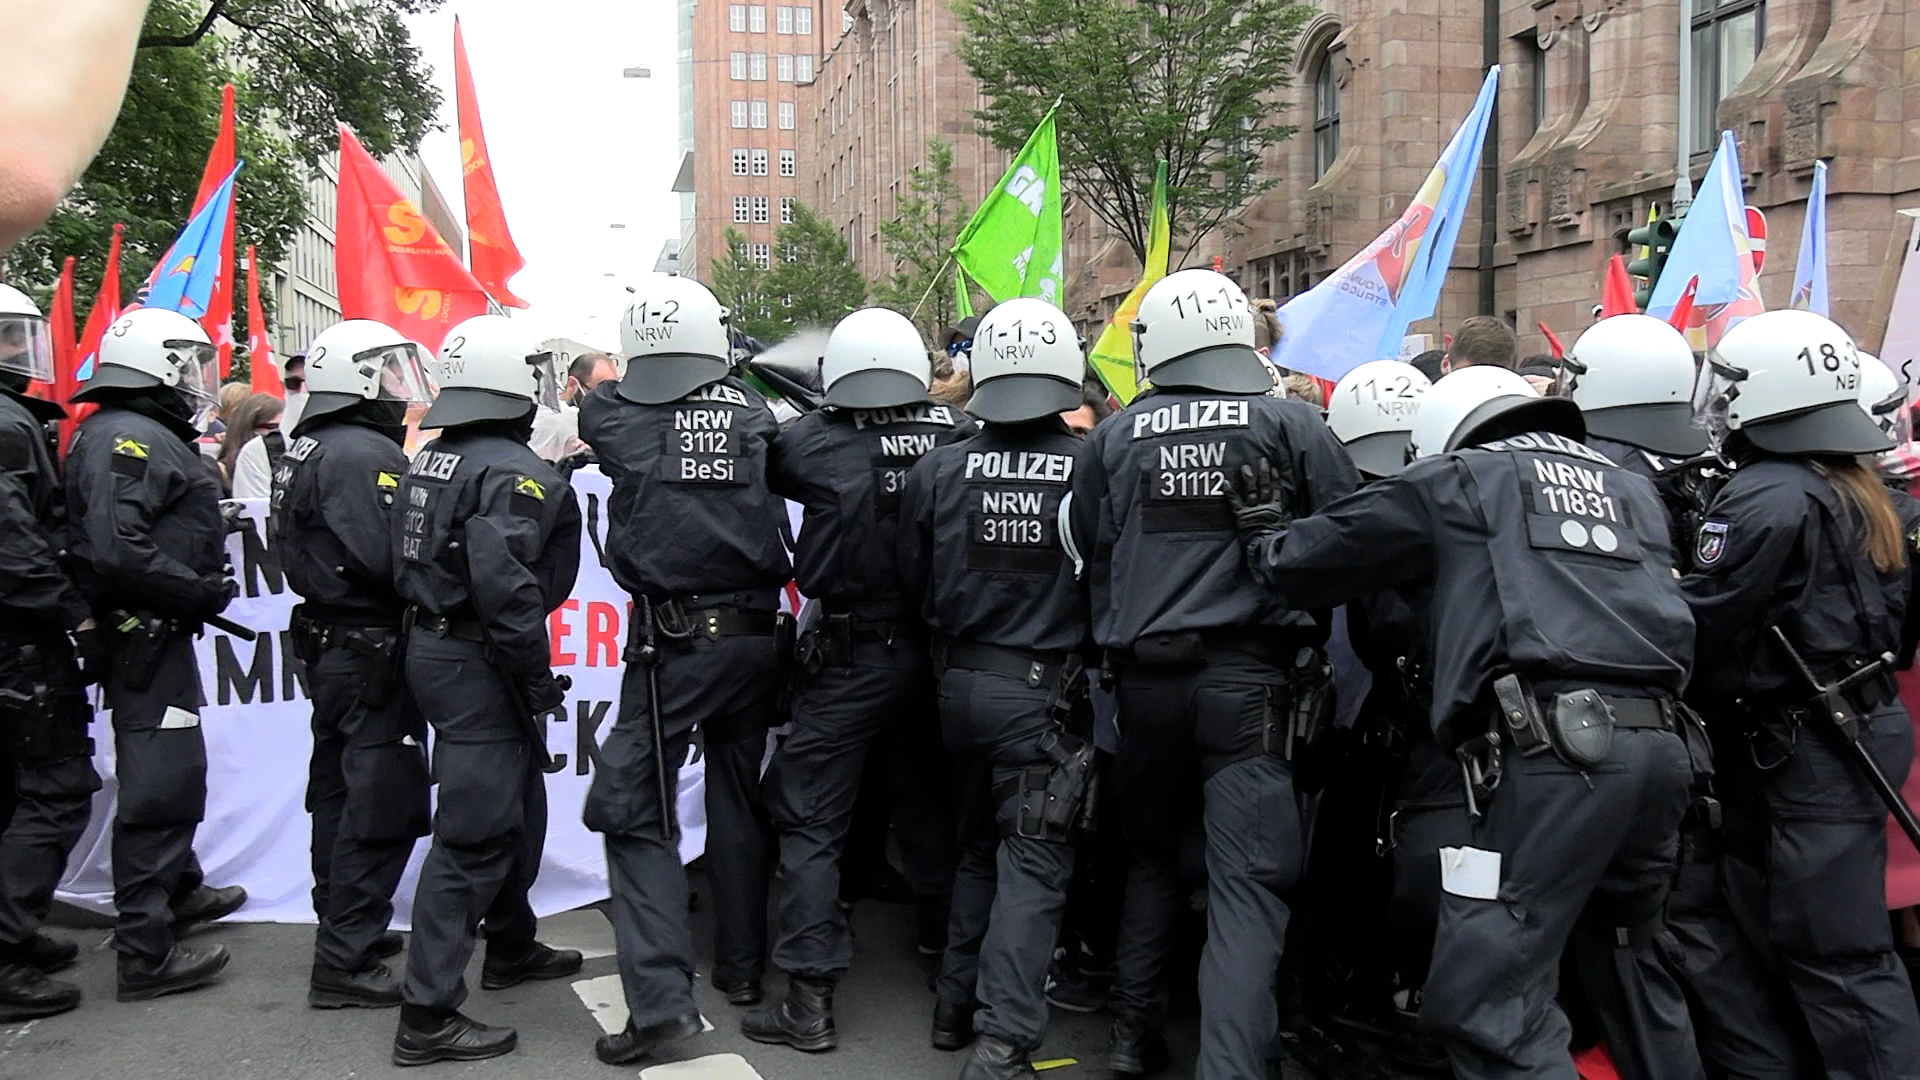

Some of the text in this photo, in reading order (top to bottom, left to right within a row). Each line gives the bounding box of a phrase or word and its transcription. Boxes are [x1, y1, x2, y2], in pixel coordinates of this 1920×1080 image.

[627, 300, 680, 326] 11-2
[1205, 316, 1244, 332] NRW
[635, 326, 673, 342] NRW
[994, 345, 1036, 360] NRW
[675, 410, 733, 430] NRW
[1133, 400, 1249, 438] POLIZEI
[1377, 401, 1422, 416] NRW
[680, 432, 728, 454] 3112
[880, 434, 936, 456] NRW
[965, 451, 1073, 482] POLIZEI
[1160, 441, 1226, 470] NRW
[681, 457, 734, 481] BeSi
[884, 469, 912, 493] 31
[1533, 458, 1605, 494] NRW
[1160, 471, 1225, 496] 31112
[982, 491, 1044, 516] NRW
[1542, 486, 1617, 523] 11831
[983, 518, 1042, 543] 31113
